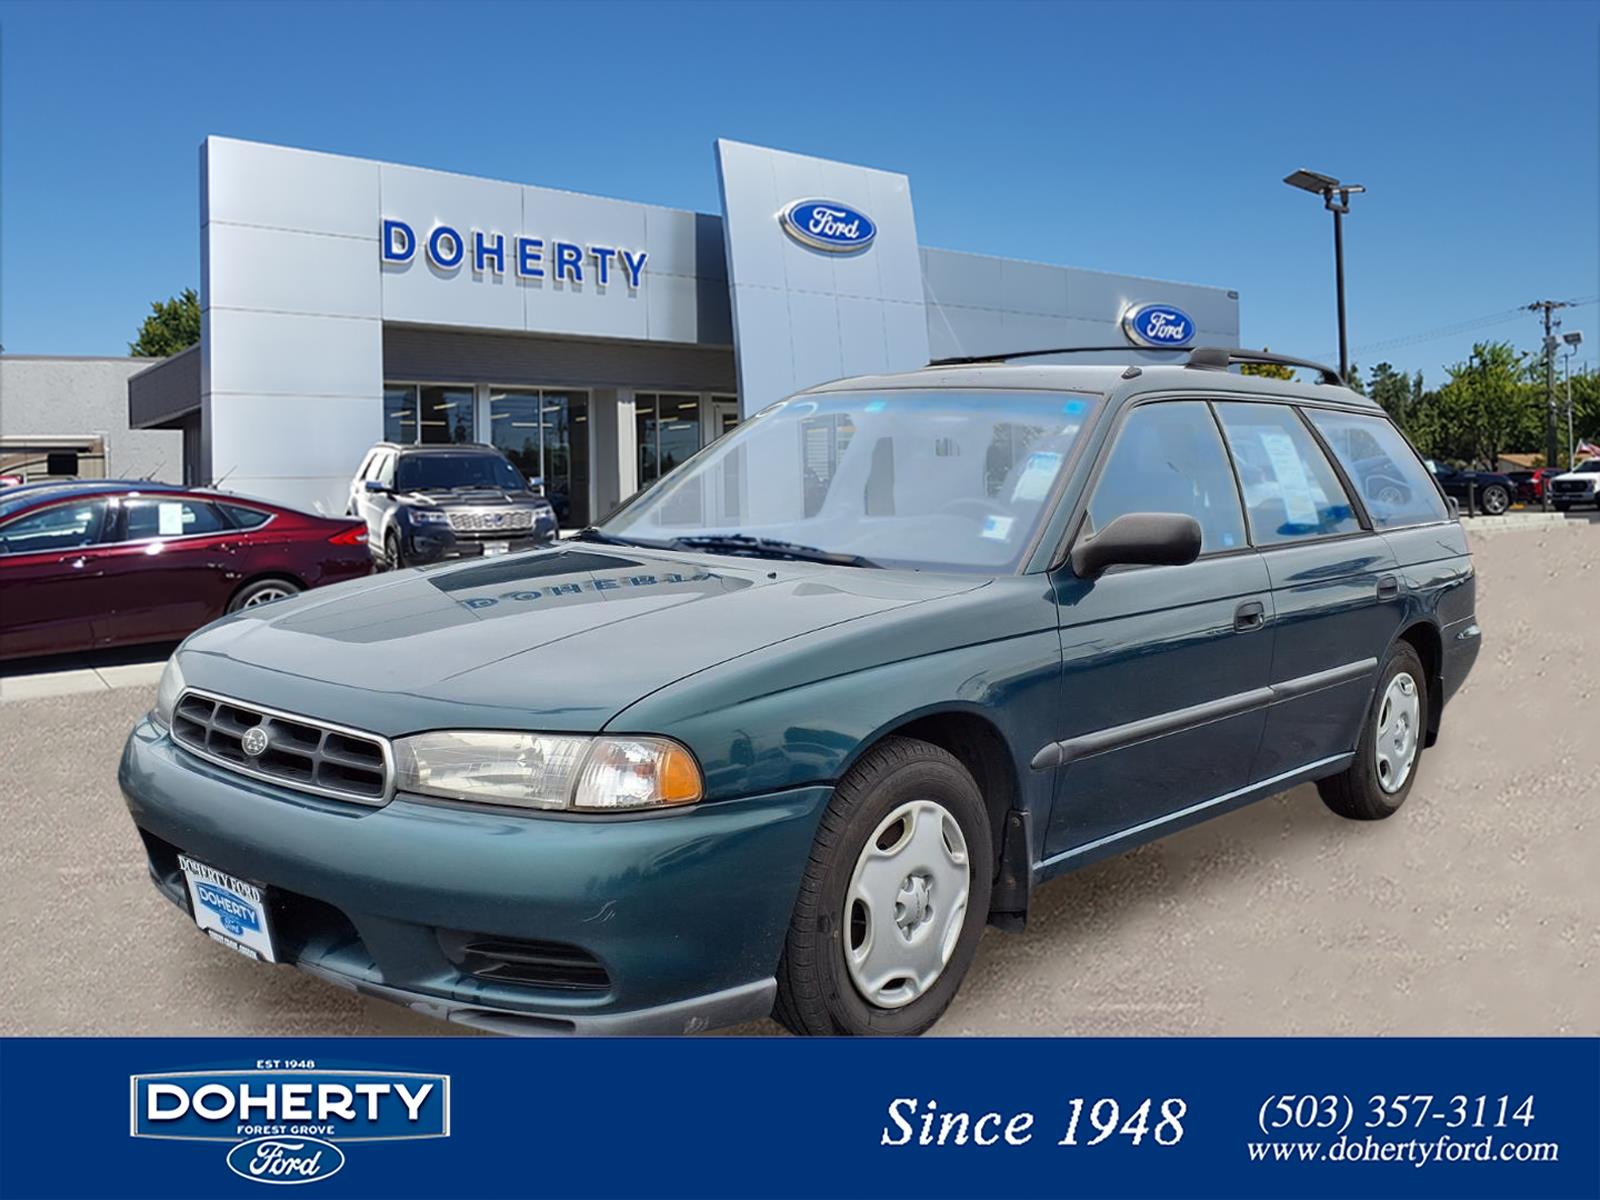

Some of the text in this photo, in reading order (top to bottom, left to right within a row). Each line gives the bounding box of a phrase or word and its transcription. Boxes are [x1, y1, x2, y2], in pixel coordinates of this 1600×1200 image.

[808, 206, 861, 239] Ford
[381, 218, 648, 289] DOHERTY
[1146, 311, 1185, 340] Ford
[179, 857, 260, 902] DOHERTY FORD
[198, 886, 256, 924] DOHERTY
